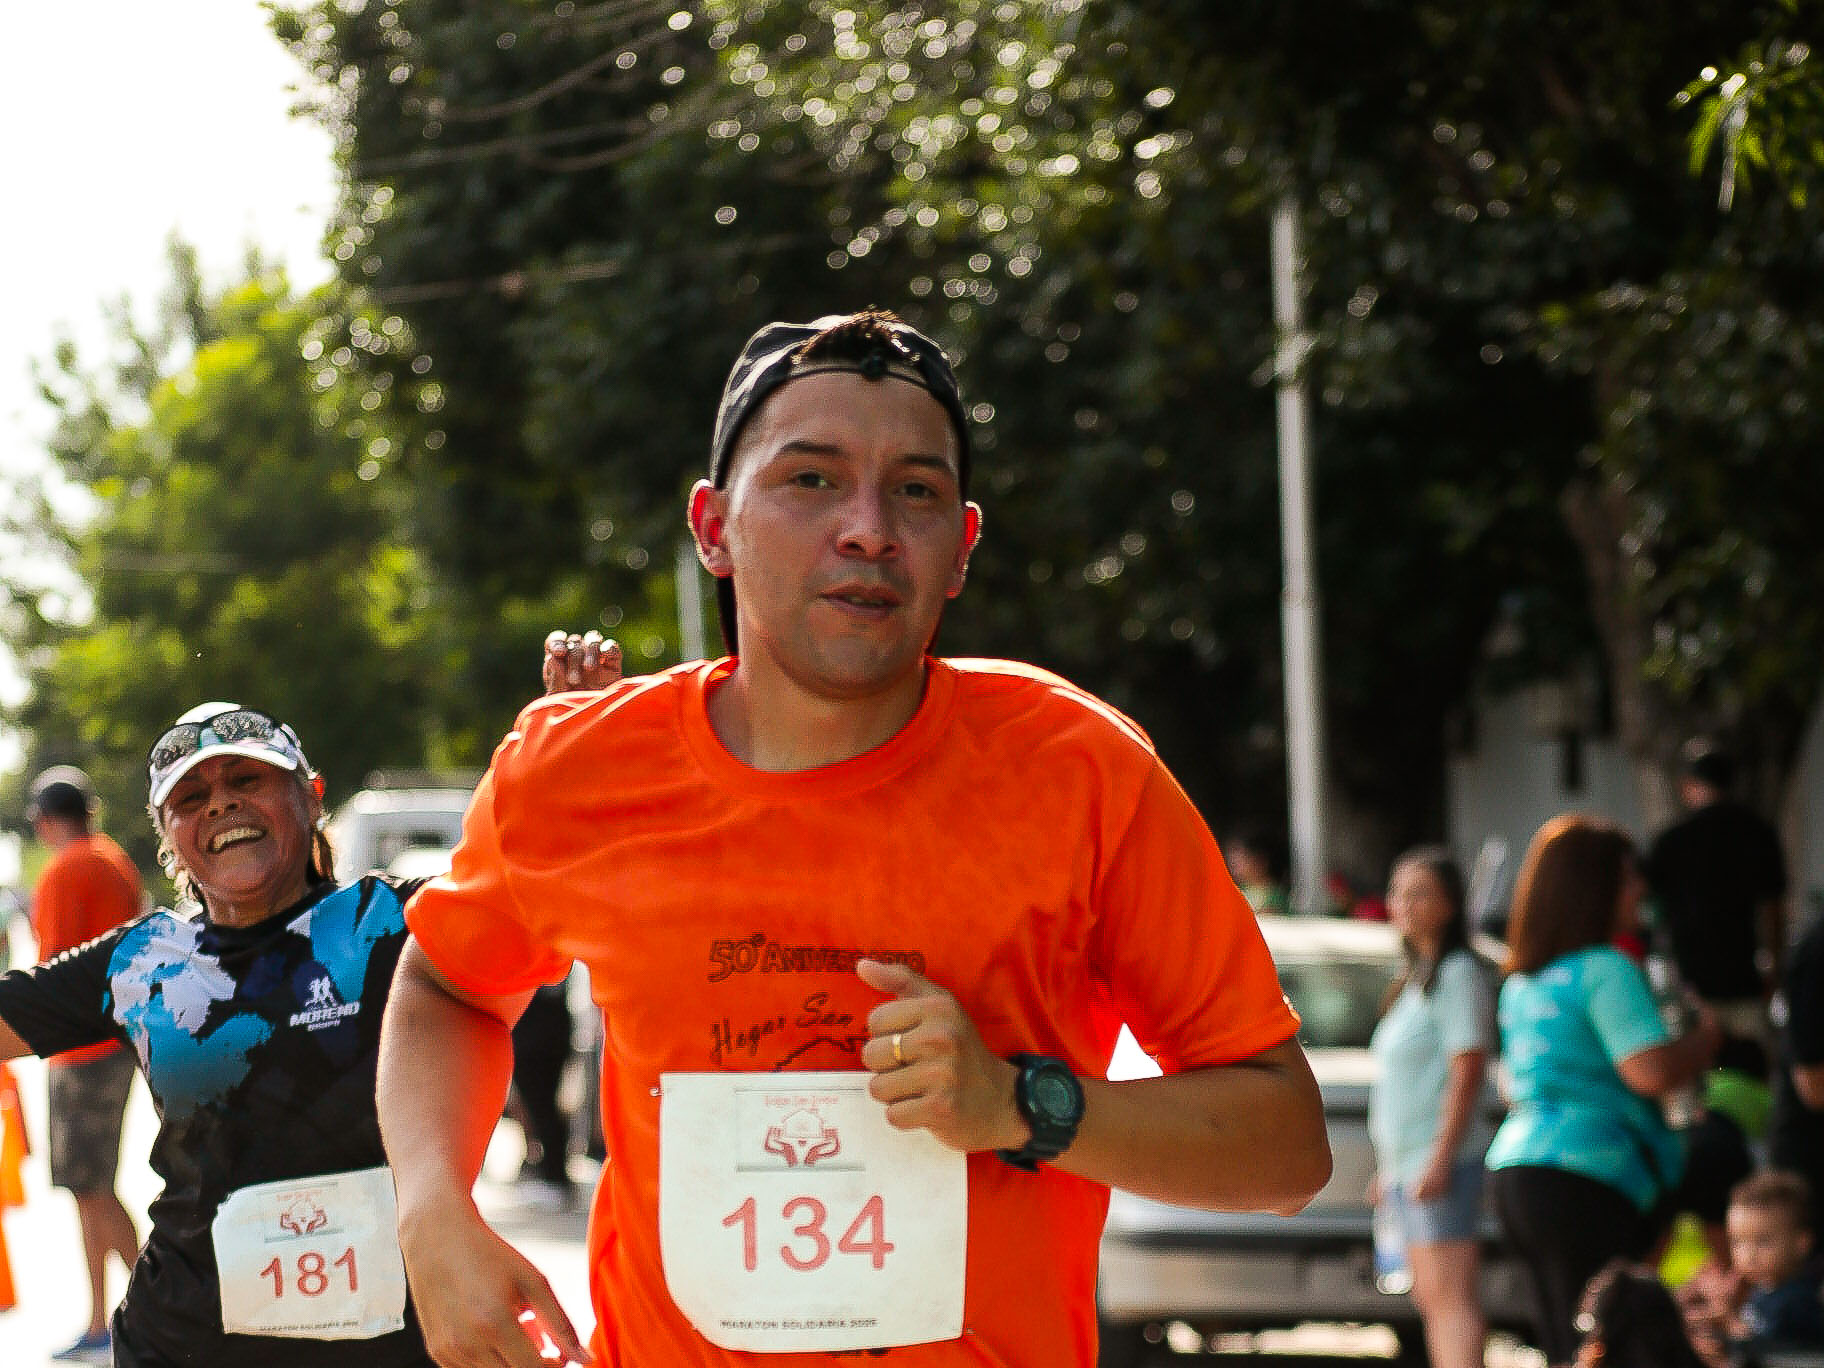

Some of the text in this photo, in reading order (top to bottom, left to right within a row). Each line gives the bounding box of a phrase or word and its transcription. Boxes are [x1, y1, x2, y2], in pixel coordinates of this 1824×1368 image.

[289, 1001, 360, 1027] MORENO
[722, 1195, 894, 1272] 134
[259, 1246, 359, 1299] 181
